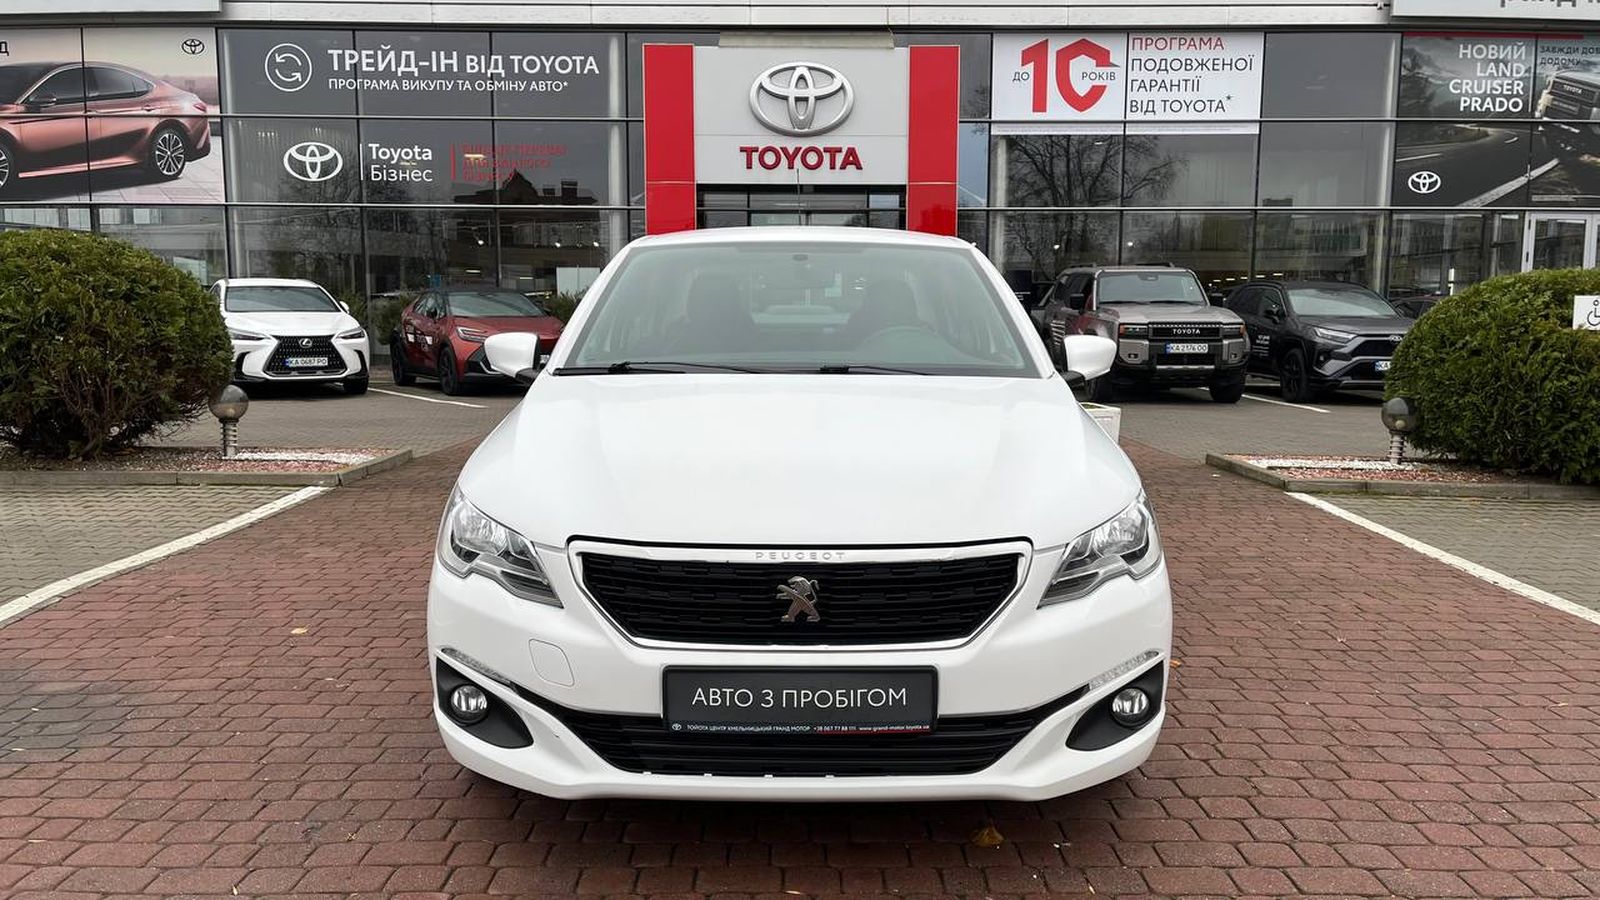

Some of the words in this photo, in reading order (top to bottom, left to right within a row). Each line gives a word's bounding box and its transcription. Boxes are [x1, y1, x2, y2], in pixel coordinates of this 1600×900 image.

[1132, 37, 1224, 51] ПРОГРАМА
[1459, 43, 1526, 59] НОВИЙ
[1540, 46, 1579, 55] ЗАВЖДИ
[328, 45, 459, 77] ТРЕЙД-ІН
[466, 55, 505, 78] ВІД
[509, 55, 600, 76] TOYOTA
[1131, 55, 1255, 75] ПОДОВЖЕНОЇ
[1540, 57, 1581, 67] ДОДОМУ
[1012, 72, 1030, 82] ДО
[1081, 72, 1116, 82] РОКІВ
[1476, 63, 1524, 77] LAND
[328, 79, 399, 92] ПРОГРАМА
[402, 79, 454, 93] ВИКУПУ
[457, 80, 473, 92] ТА
[475, 80, 527, 93] ОБМІНУ
[1130, 75, 1200, 93] ГАРАНТІЇ
[1449, 79, 1523, 95] CRUISER
[1130, 100, 1156, 116] ВІД
[1459, 97, 1523, 112] PRADO
[368, 144, 433, 164] Toyota
[739, 146, 863, 170] TOYOTA
[370, 165, 434, 184] Бізнес
[755, 551, 847, 561] PEUGEOT
[692, 688, 753, 707] АВТО
[761, 689, 773, 707] З
[782, 688, 907, 708] ПРОБІГОМ
